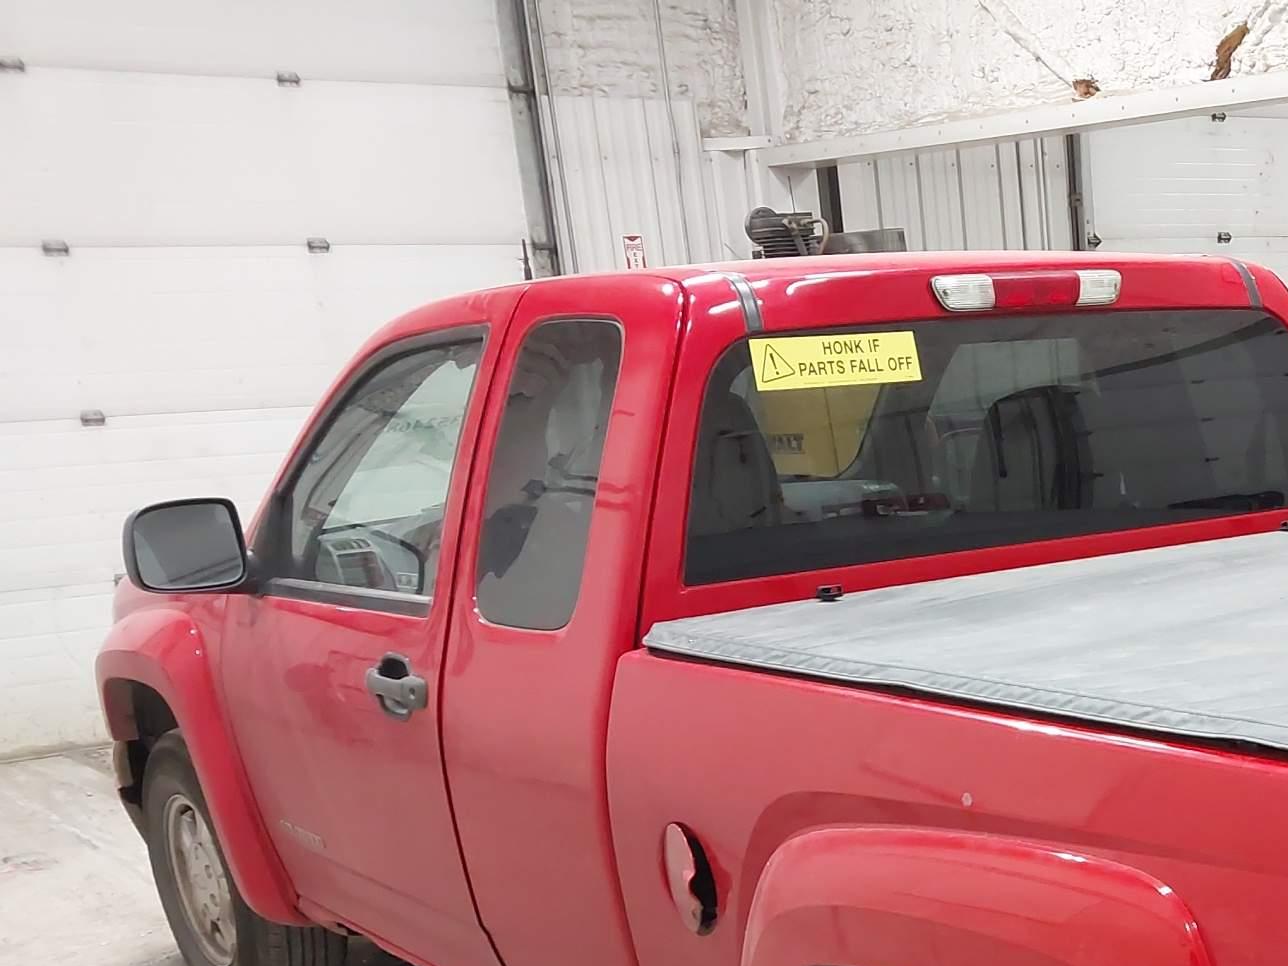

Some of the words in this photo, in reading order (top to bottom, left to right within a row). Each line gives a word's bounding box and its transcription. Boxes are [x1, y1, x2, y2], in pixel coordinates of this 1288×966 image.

[822, 340, 864, 355] HONK
[868, 339, 880, 353] IF
[798, 360, 845, 376] PARTS
[850, 358, 884, 373] FALL
[887, 356, 913, 371] OFF
